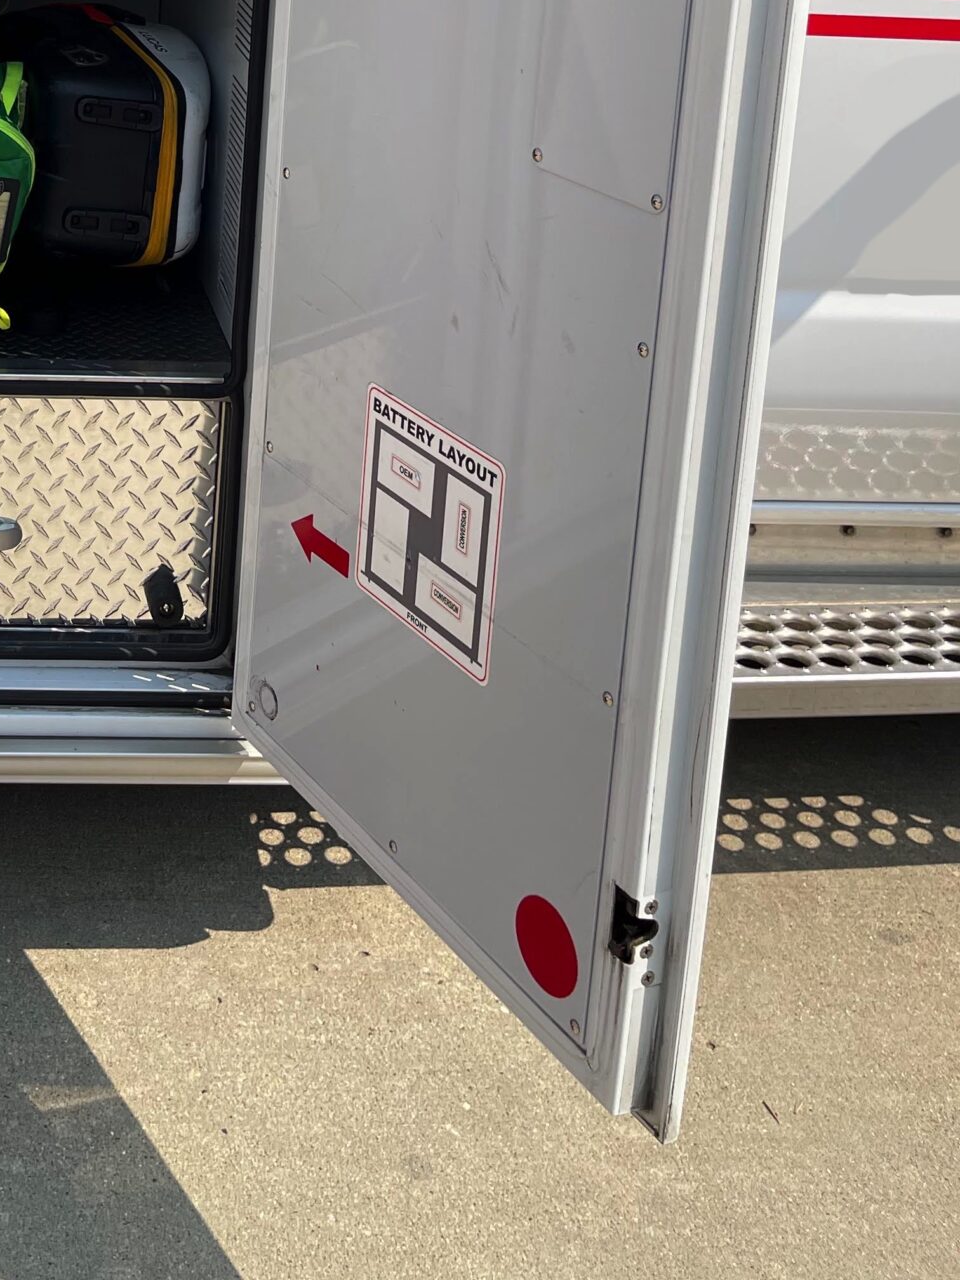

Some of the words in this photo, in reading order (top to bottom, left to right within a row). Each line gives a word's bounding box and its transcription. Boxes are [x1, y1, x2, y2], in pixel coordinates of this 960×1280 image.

[373, 397, 435, 447] BATTERY
[438, 438, 498, 487] LAYOUT
[399, 465, 413, 481] OEM
[458, 508, 467, 549] CONVERSION
[433, 588, 459, 614] CONVERSION
[406, 611, 428, 634] FRONT
